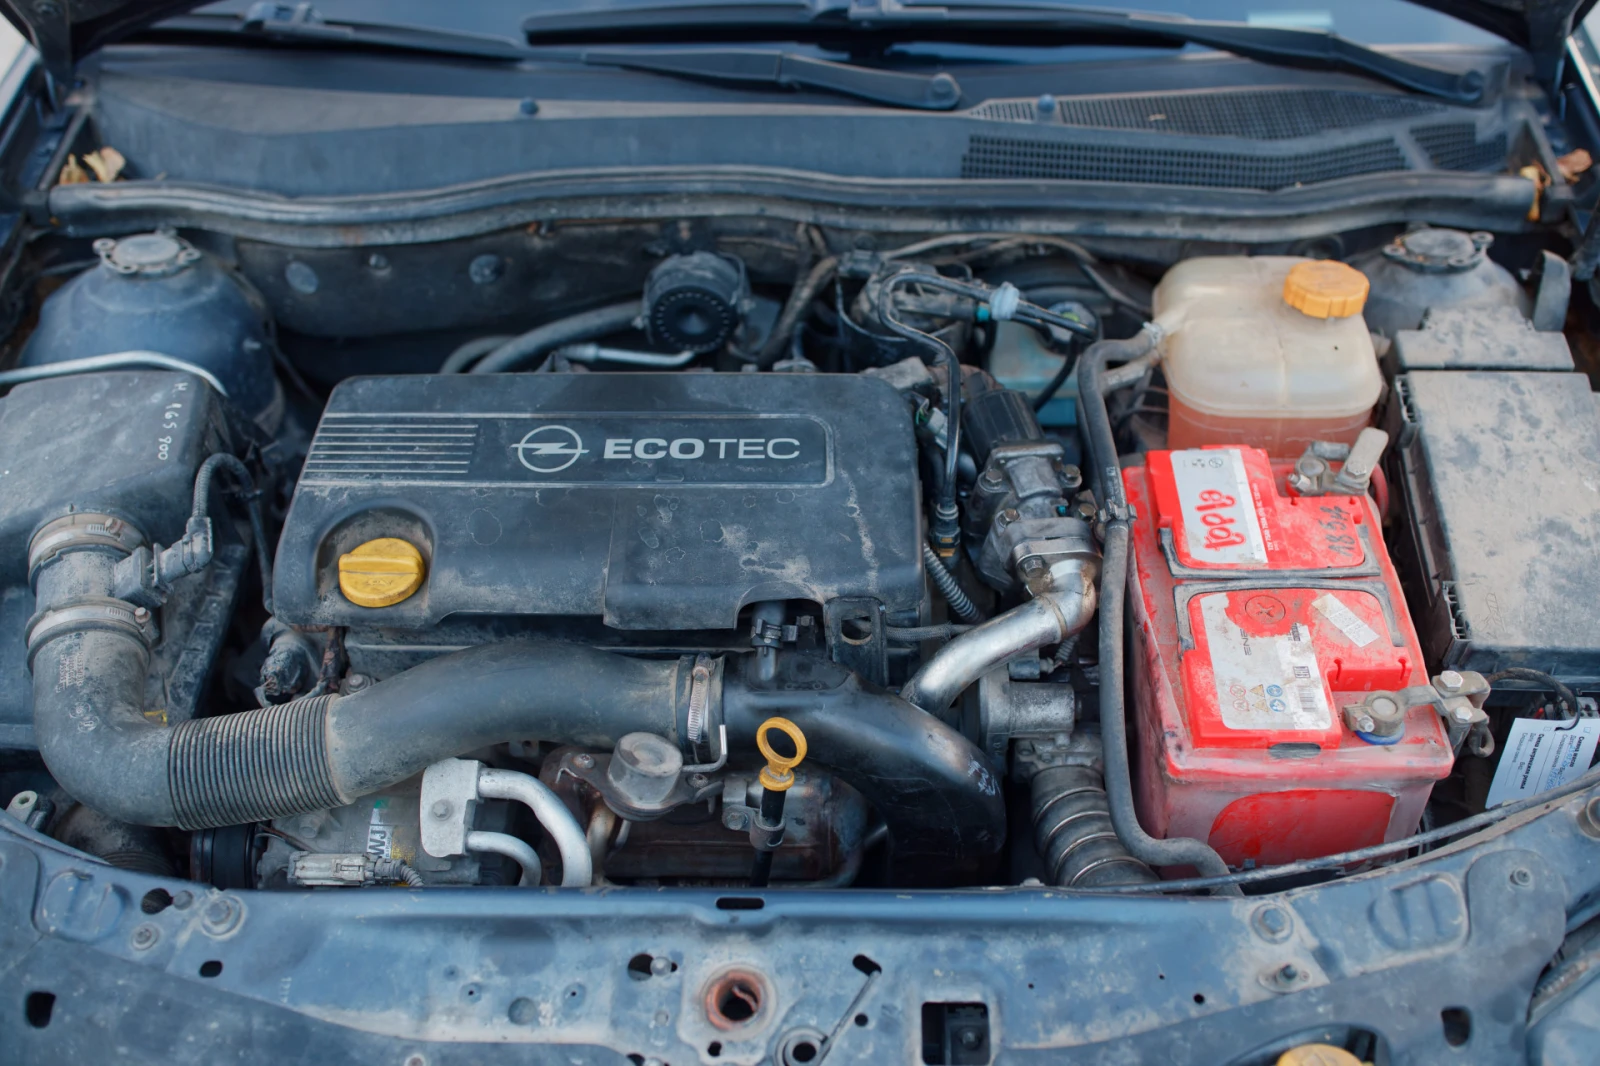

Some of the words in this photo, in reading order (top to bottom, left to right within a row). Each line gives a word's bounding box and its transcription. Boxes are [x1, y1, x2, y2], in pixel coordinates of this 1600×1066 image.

[163, 403, 182, 429] 165
[158, 435, 172, 460] 900
[603, 438, 800, 459] ECOTEC
[1194, 489, 1247, 551] topla
